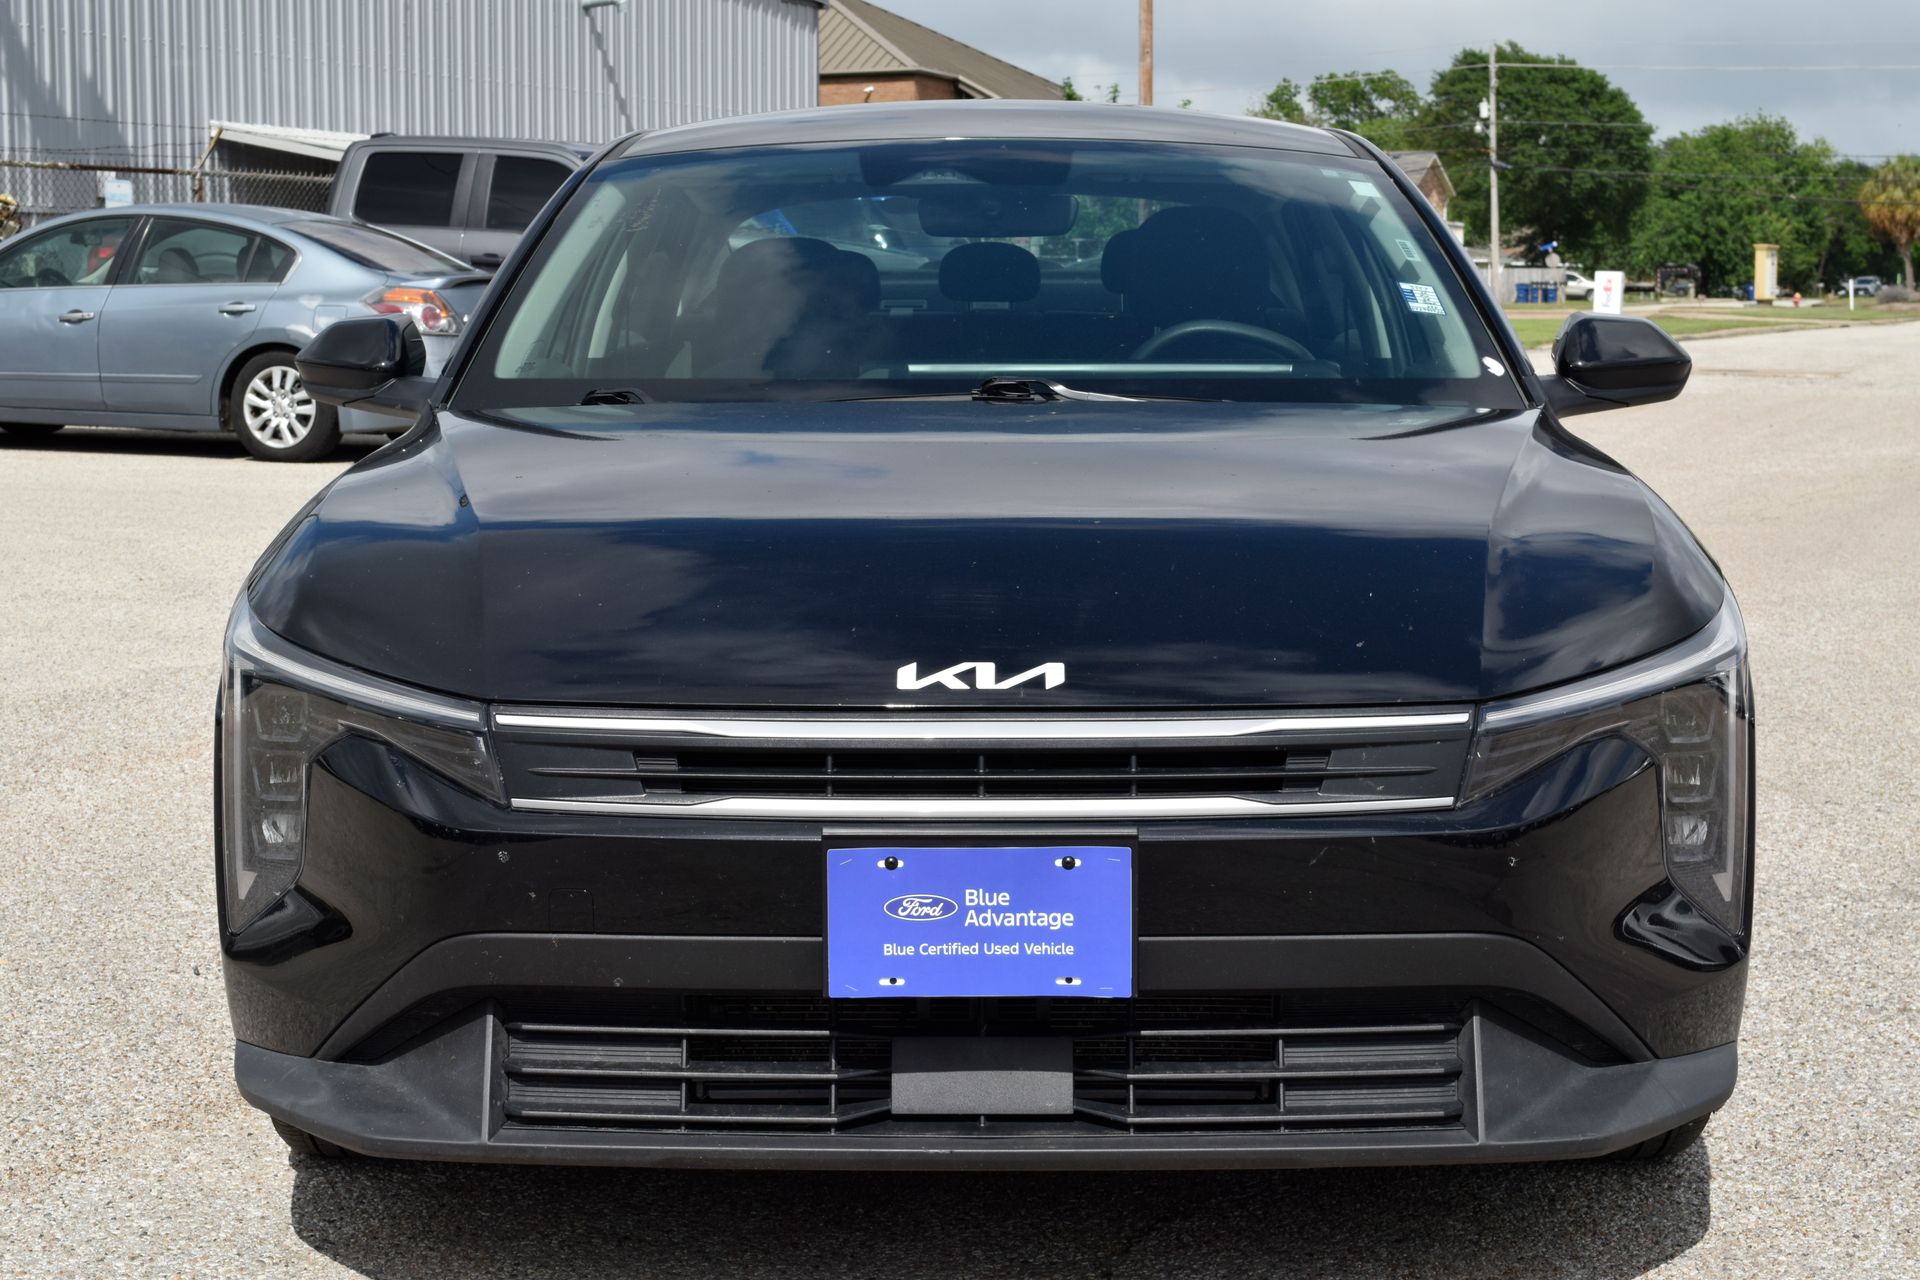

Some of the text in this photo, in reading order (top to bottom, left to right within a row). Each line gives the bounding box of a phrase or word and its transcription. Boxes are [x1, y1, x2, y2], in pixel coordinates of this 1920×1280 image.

[897, 662, 1065, 689] KIA
[965, 889, 1010, 906] Blue
[898, 898, 944, 916] Ford
[964, 909, 1074, 930] Advantage
[883, 943, 1074, 956] Blue Certified Used Vehicle
